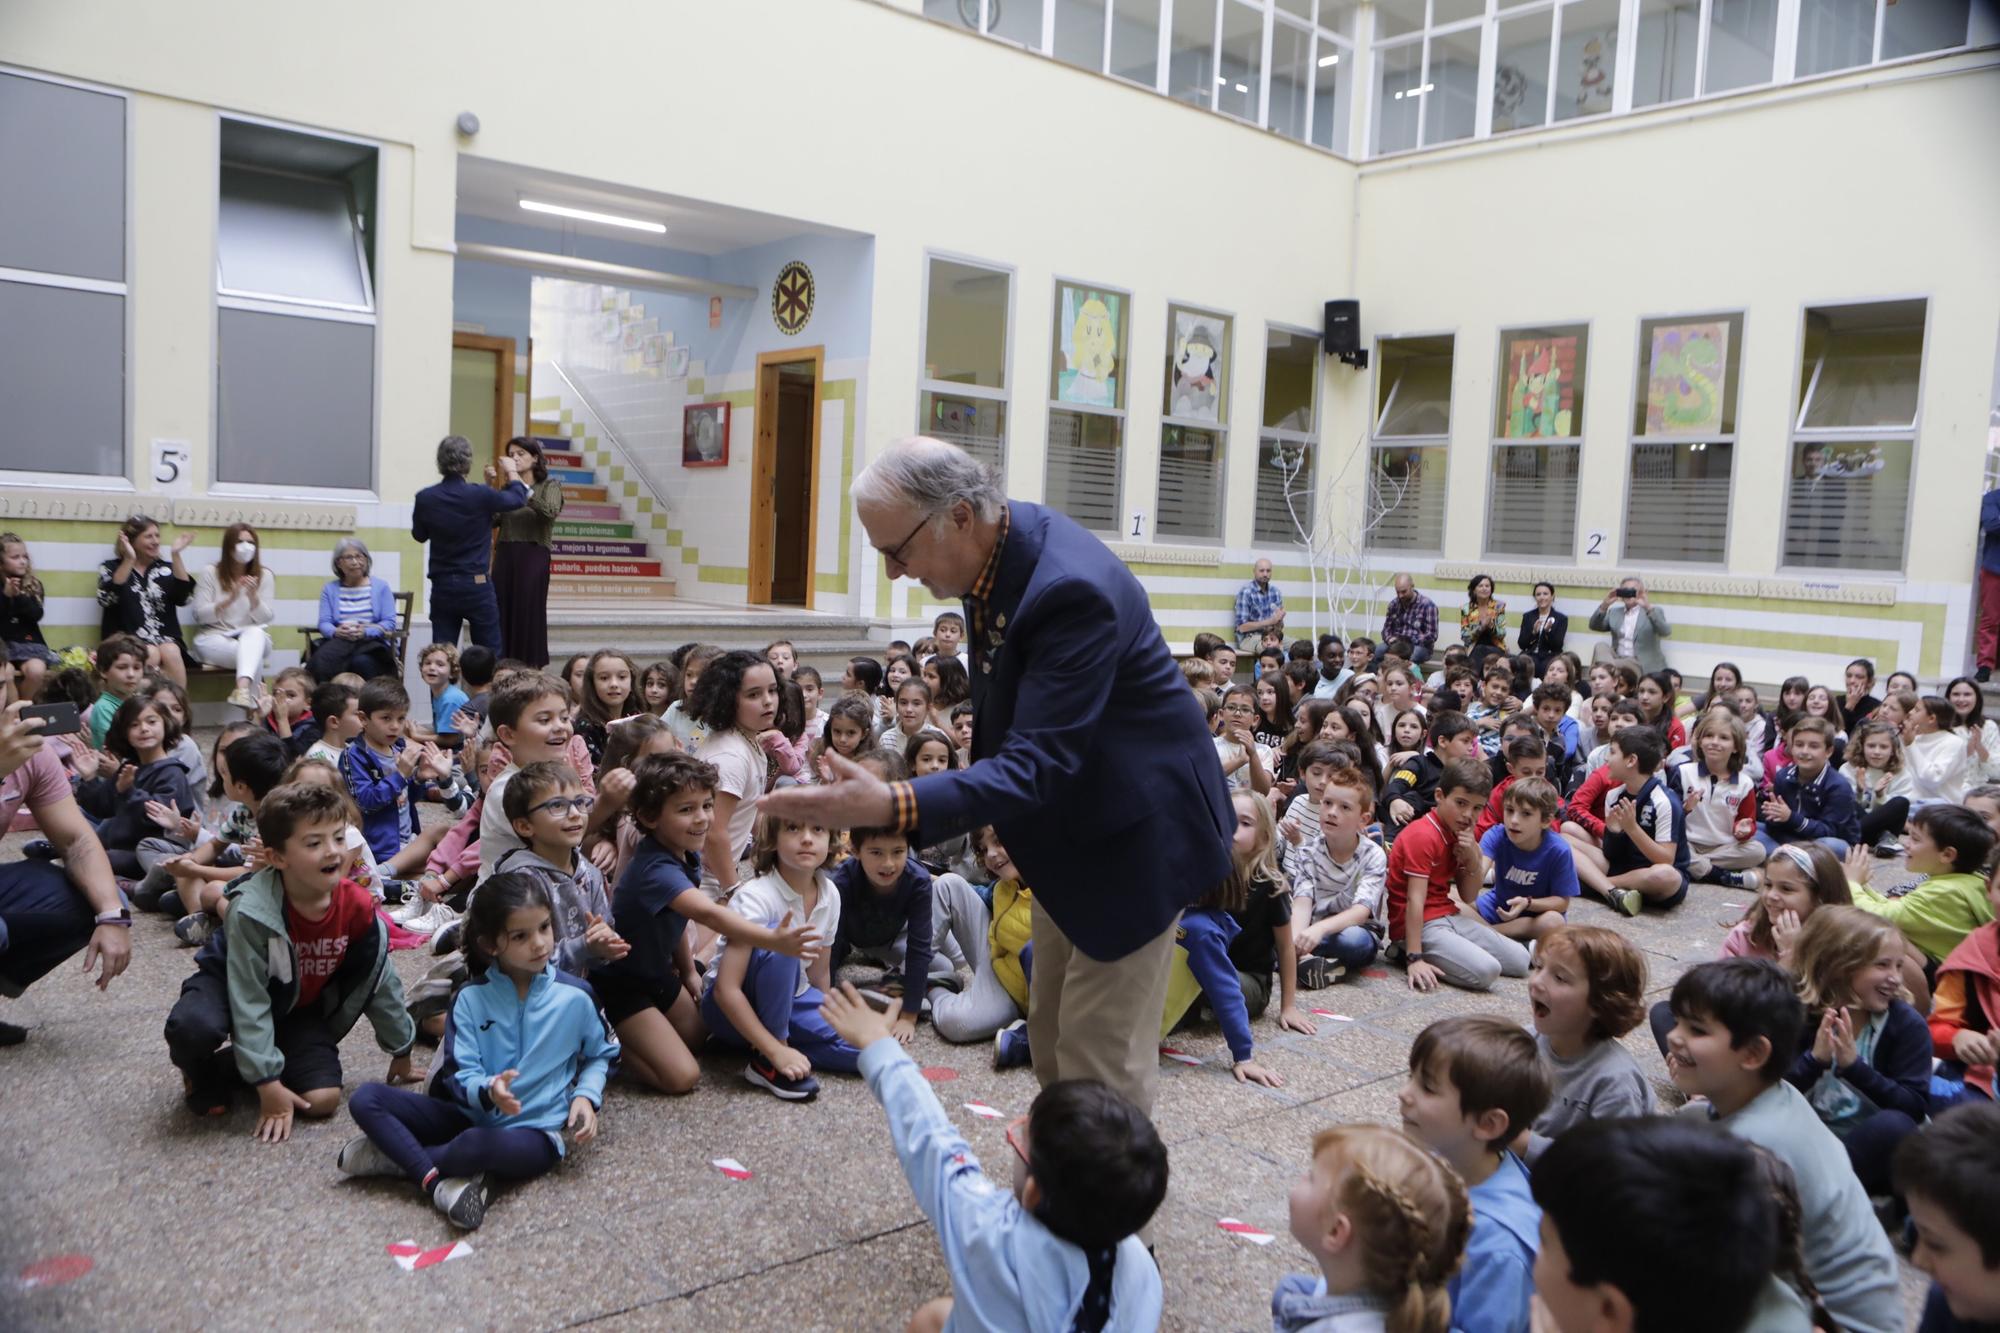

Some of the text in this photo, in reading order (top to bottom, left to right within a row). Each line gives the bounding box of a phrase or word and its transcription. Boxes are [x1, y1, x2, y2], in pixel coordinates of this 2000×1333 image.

[562, 544, 586, 555] mejora
[585, 565, 610, 574] puedes
[1505, 865, 1539, 886] NIKE
